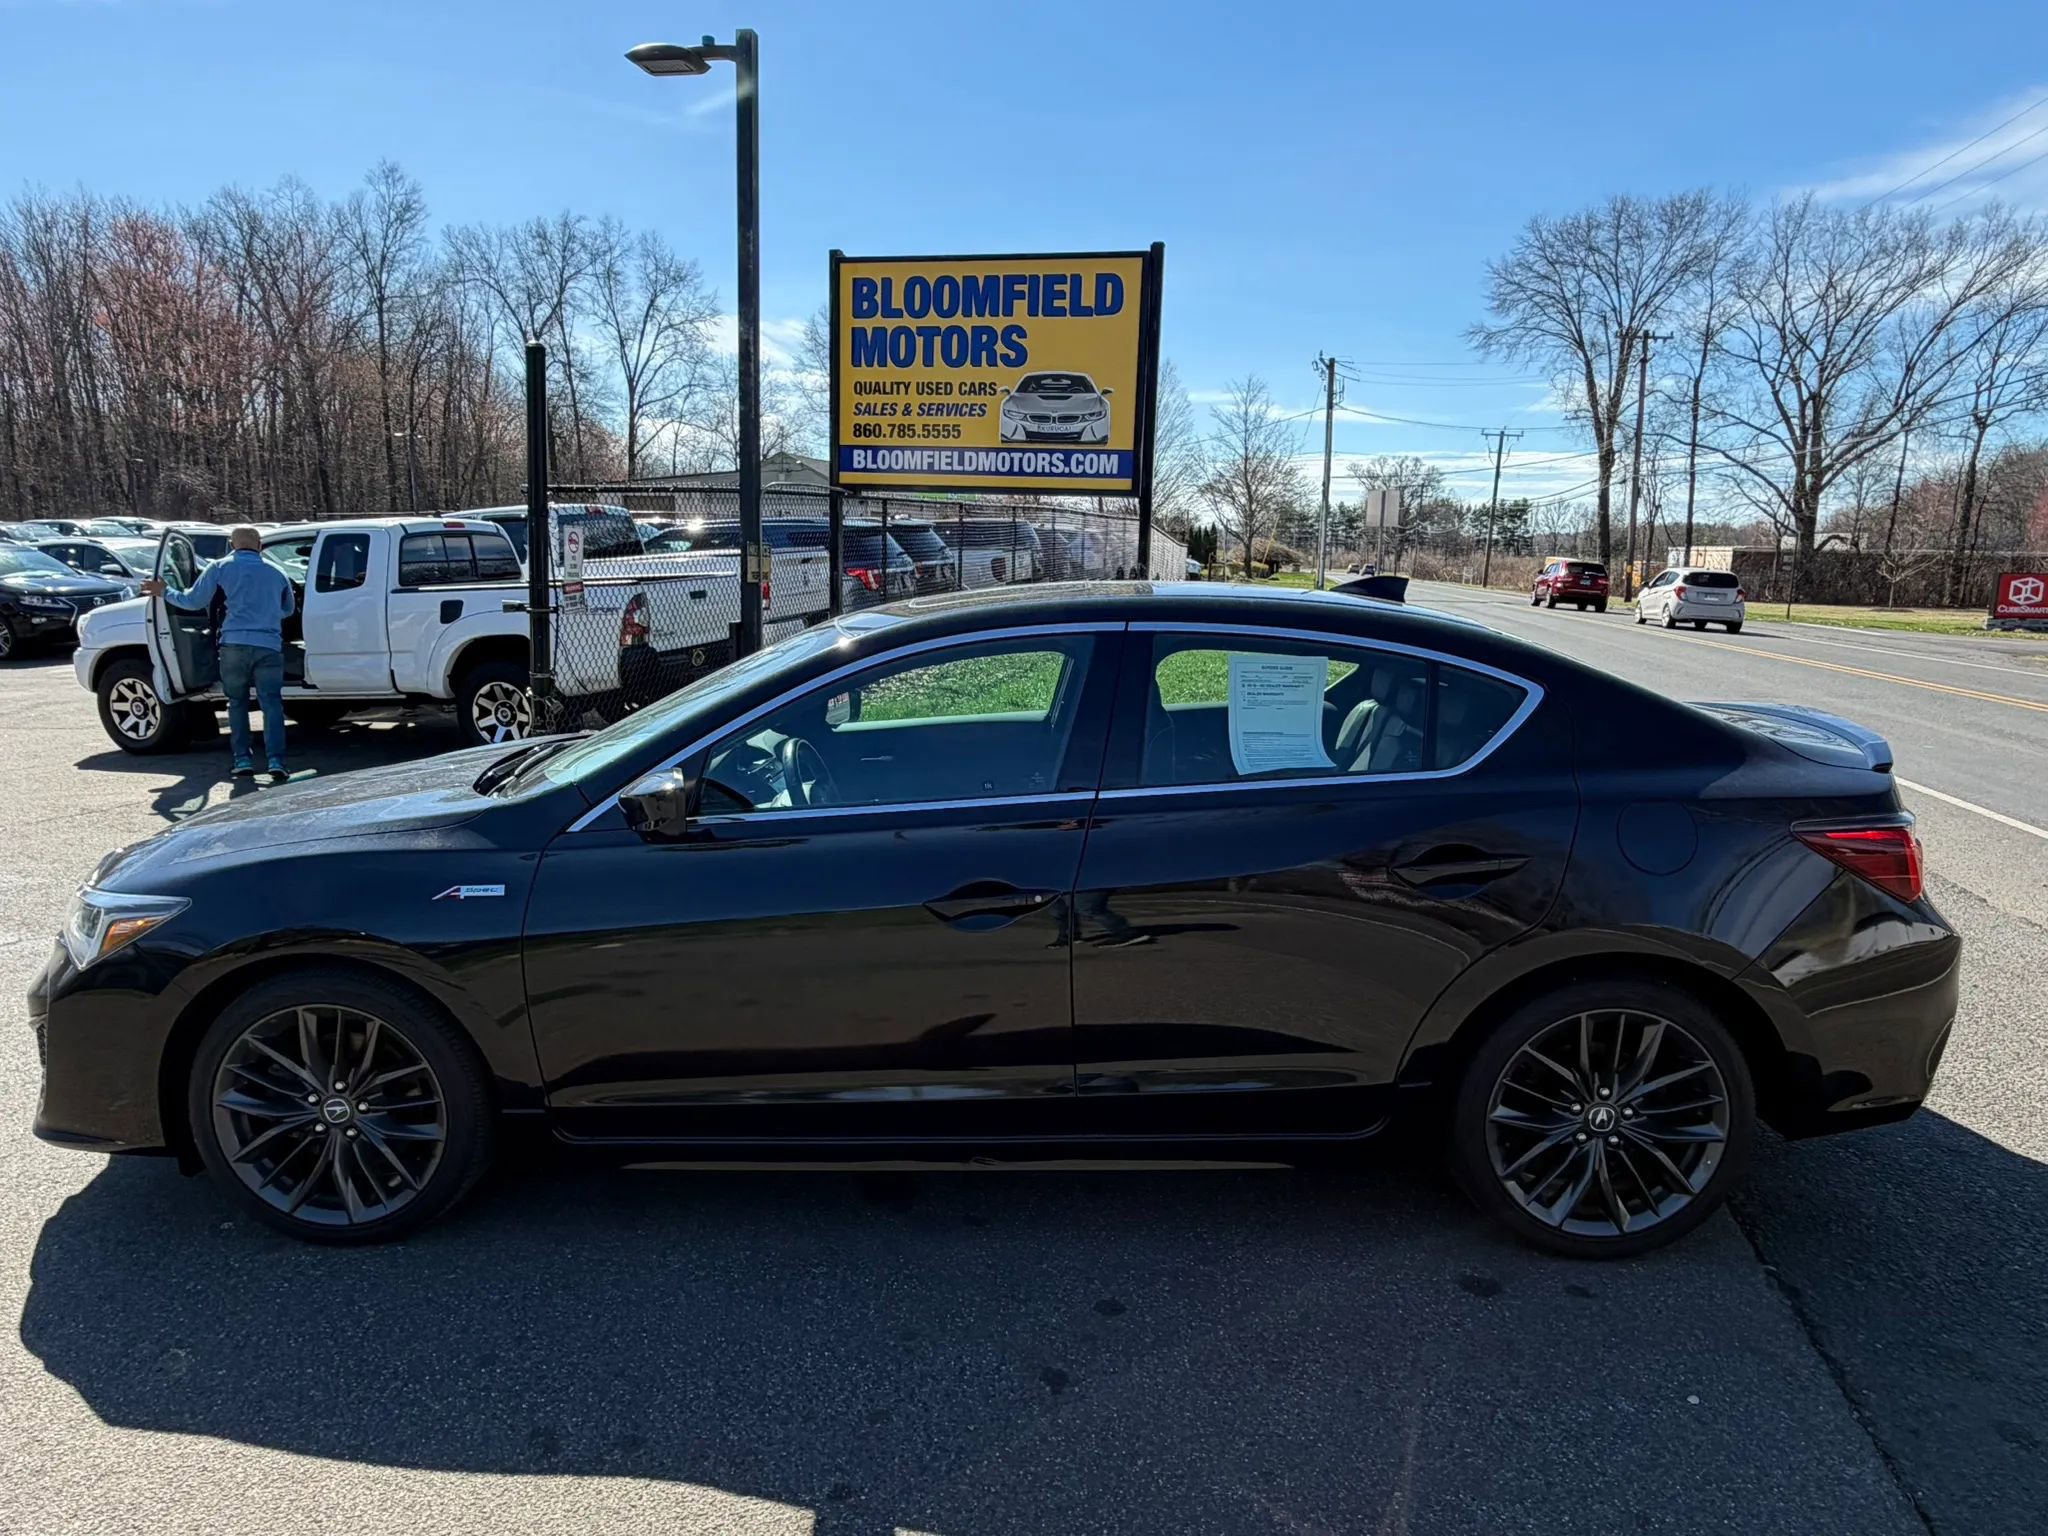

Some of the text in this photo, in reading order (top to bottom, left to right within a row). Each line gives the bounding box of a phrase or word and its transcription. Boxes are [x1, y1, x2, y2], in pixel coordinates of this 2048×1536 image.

[851, 272, 1125, 319] BLOOMFIELD
[851, 324, 1029, 368] MOTORS
[853, 381, 998, 396] QUALITY USED CARS
[853, 403, 988, 417] SALES & SERVICES
[852, 423, 962, 440] 860.785.5555
[852, 449, 1119, 475] BLOOMFIELDMOTORS.COM
